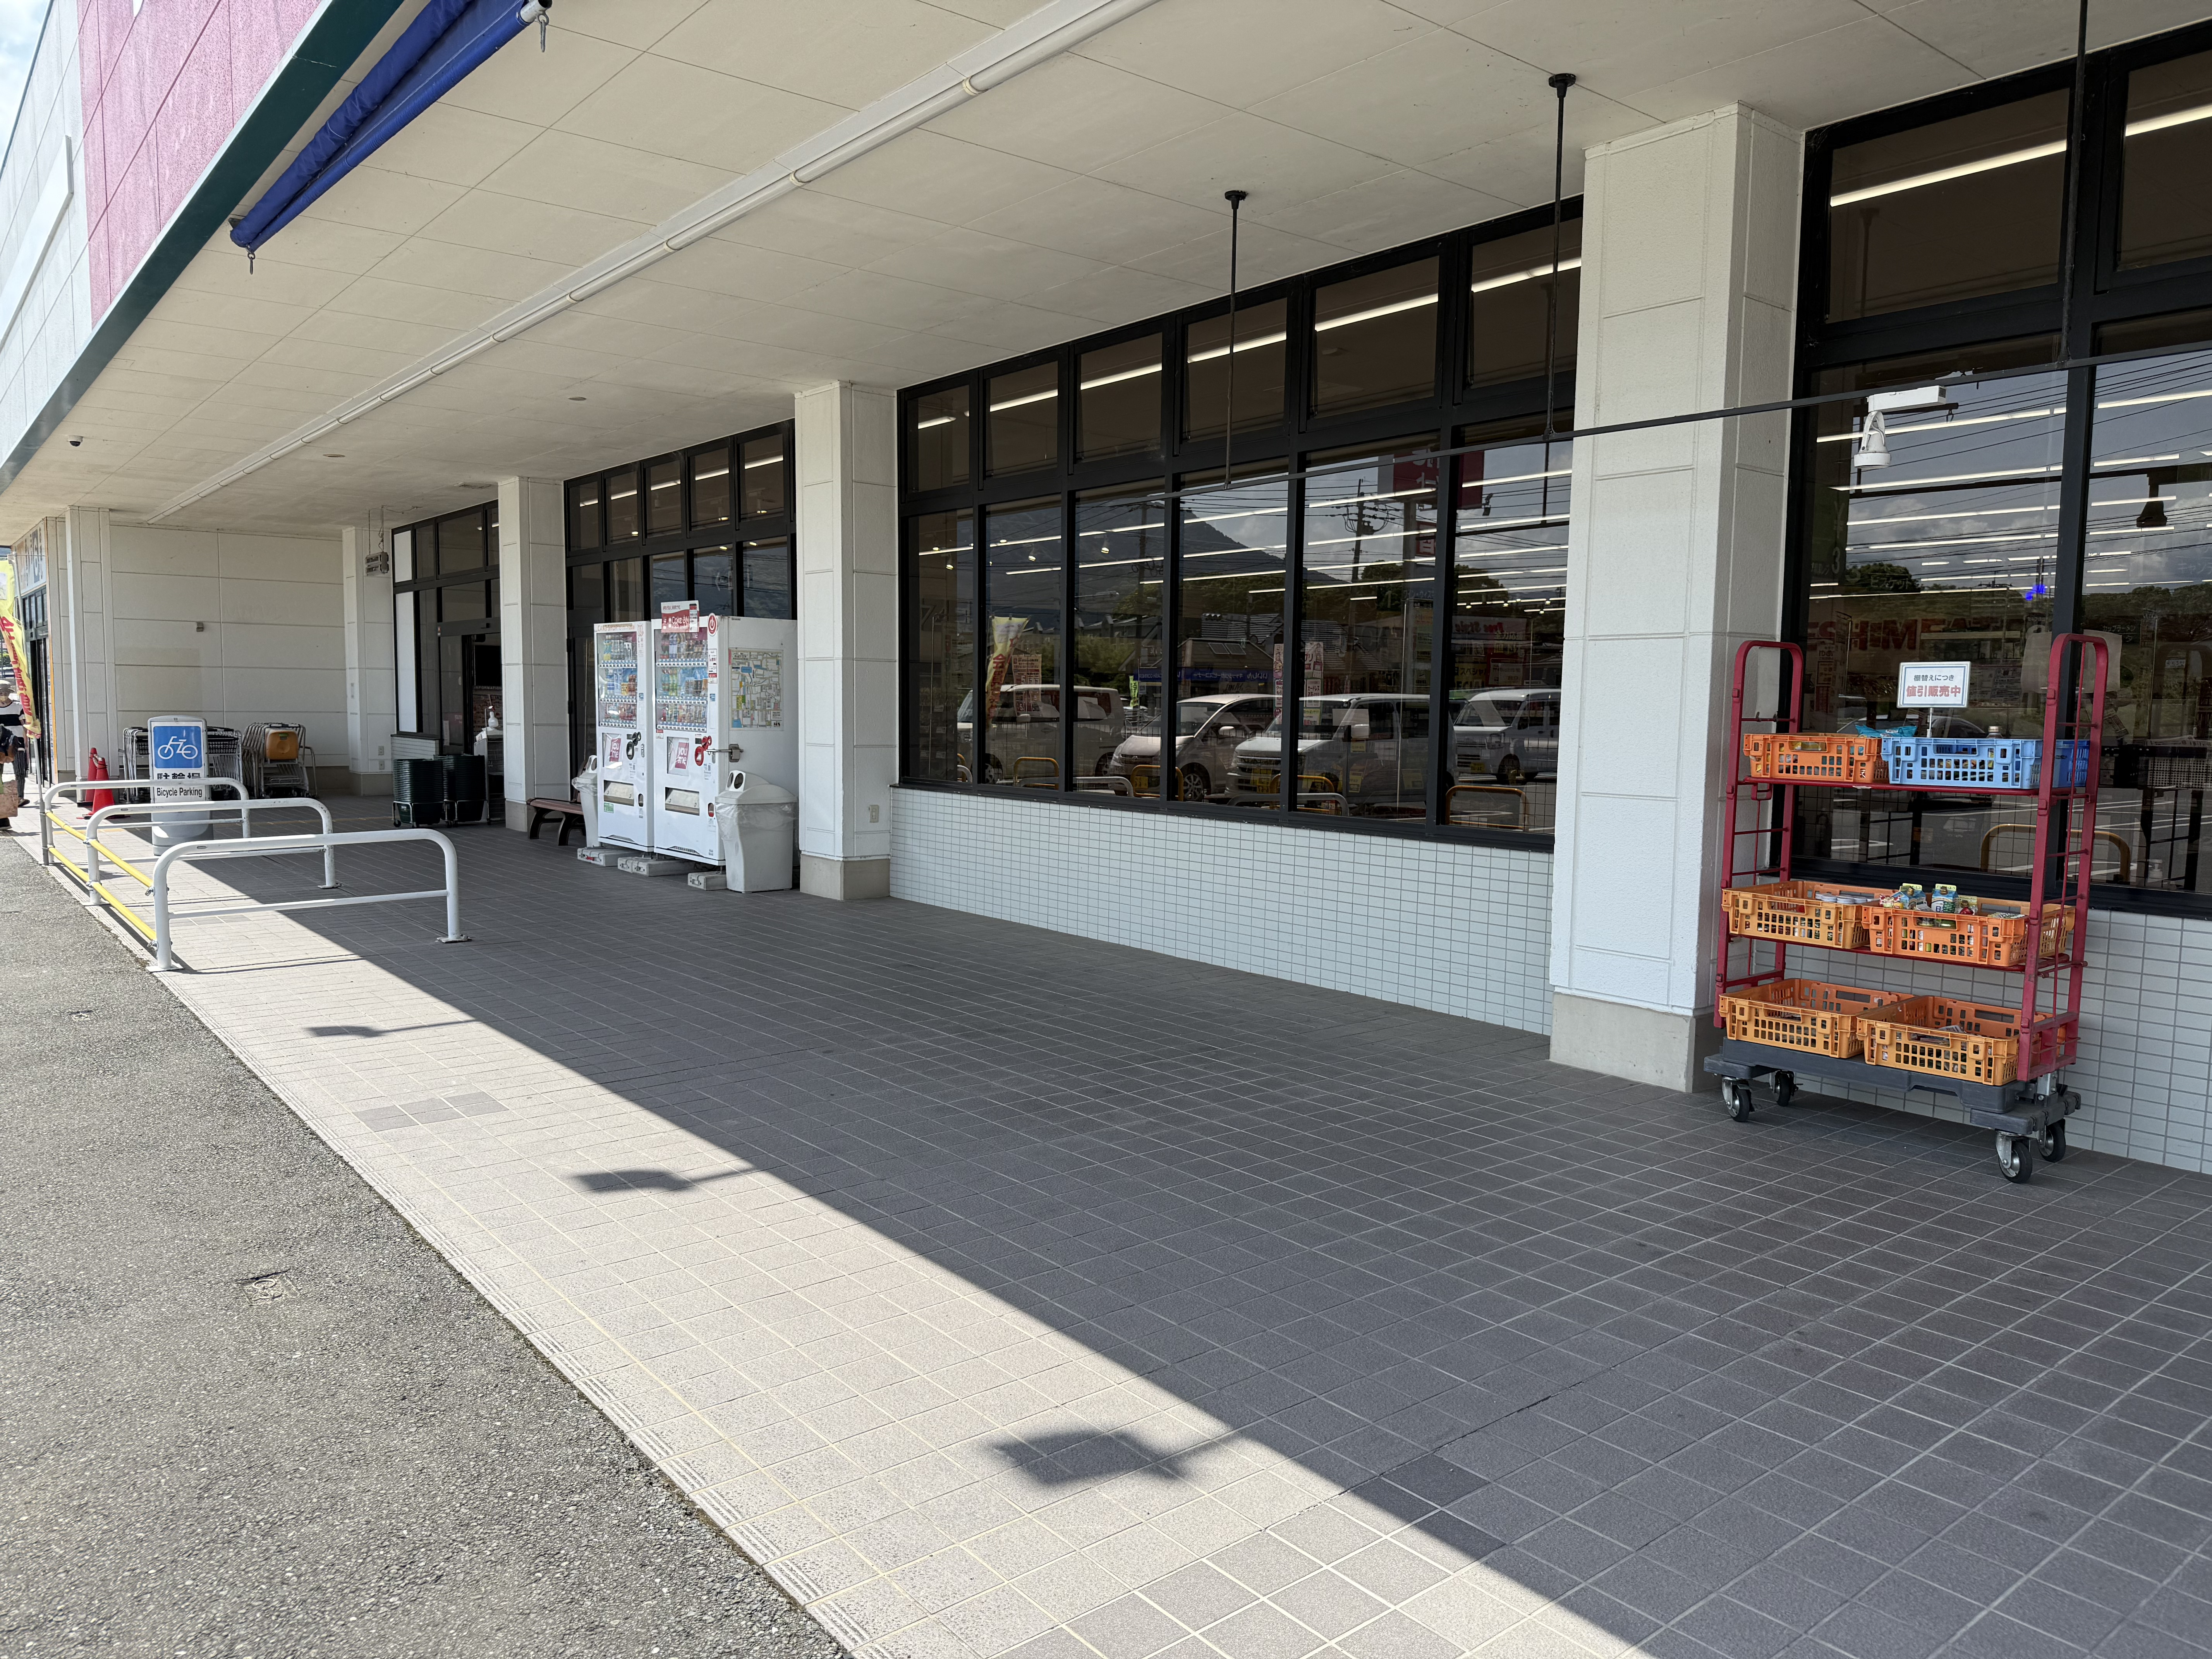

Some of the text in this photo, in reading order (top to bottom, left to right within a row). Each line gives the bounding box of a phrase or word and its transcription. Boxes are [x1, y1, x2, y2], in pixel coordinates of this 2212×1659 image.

[1906, 685, 1961, 697] 値引販売中
[677, 747, 688, 757] you
[678, 756, 687, 764] me
[157, 787, 202, 798] Bicycle Parking
